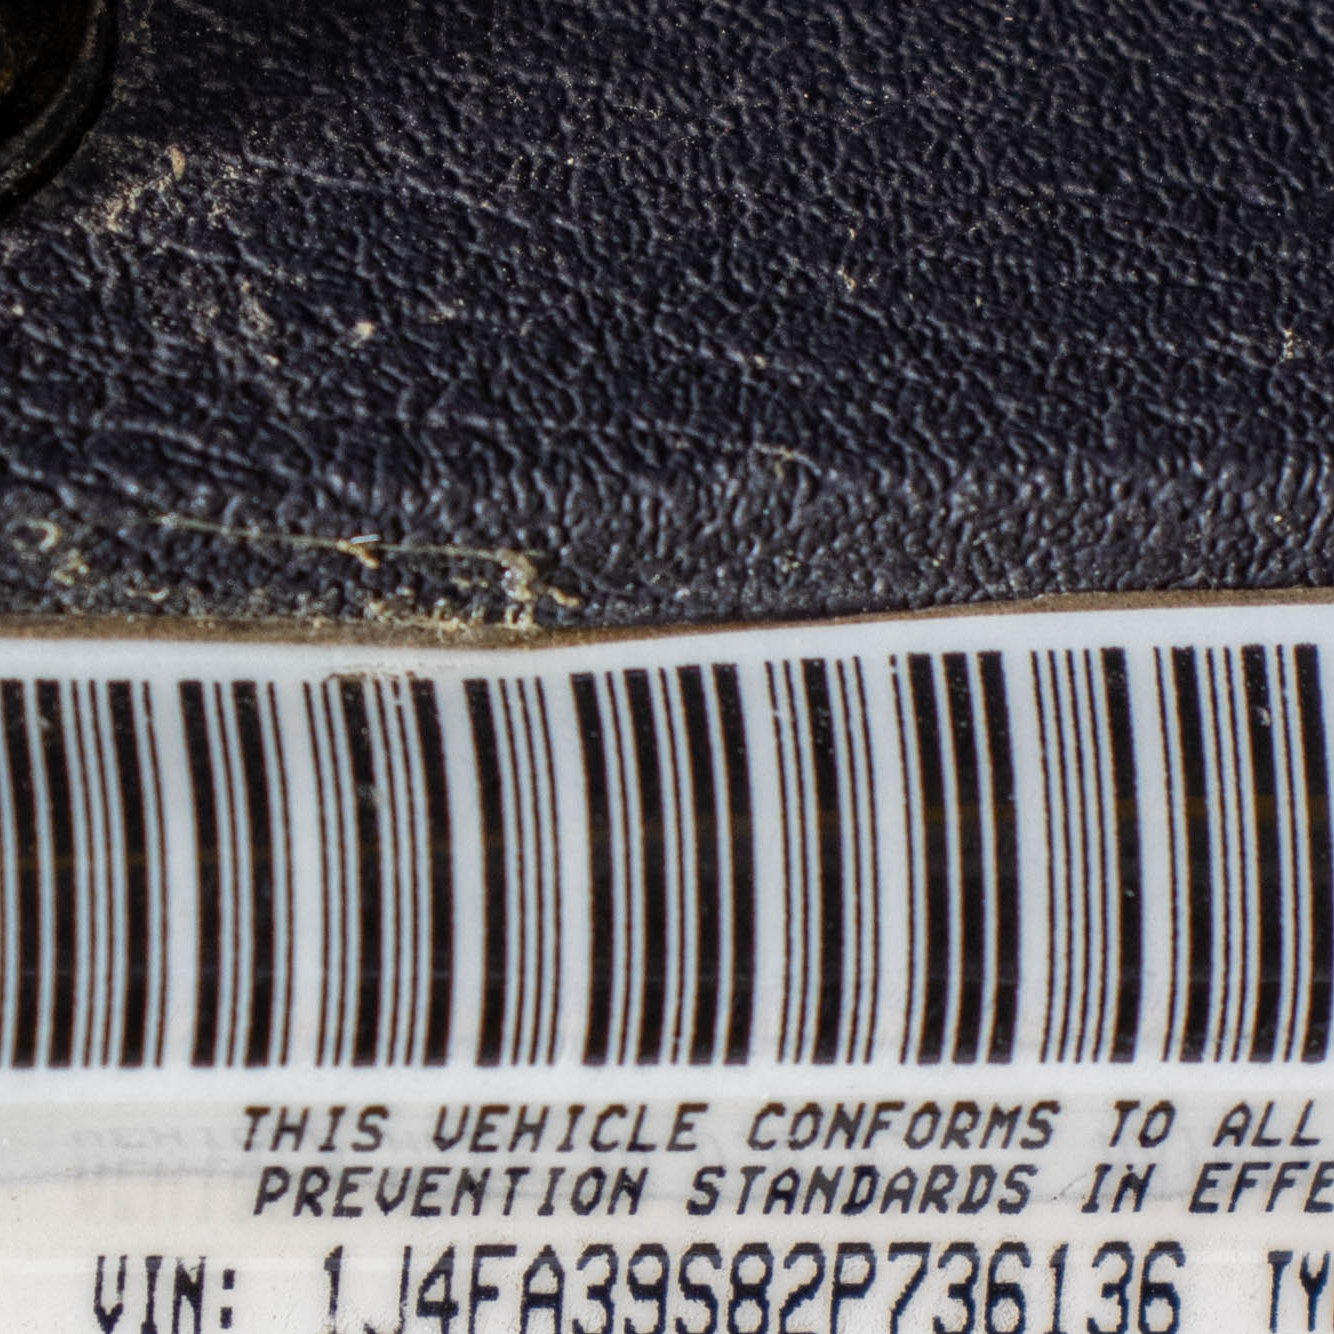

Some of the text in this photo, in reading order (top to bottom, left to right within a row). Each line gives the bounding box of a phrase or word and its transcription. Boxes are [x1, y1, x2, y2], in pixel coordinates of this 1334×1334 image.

[243, 1104, 390, 1153] THIS
[431, 1102, 709, 1154] VEHICLE
[746, 1099, 1062, 1151] CONFORMS
[1109, 1099, 1176, 1149] TO
[1212, 1100, 1321, 1148] ALL
[253, 1165, 649, 1218] PREVENTION
[685, 1163, 1038, 1217] STANDARDS
[1081, 1163, 1157, 1214] IN
